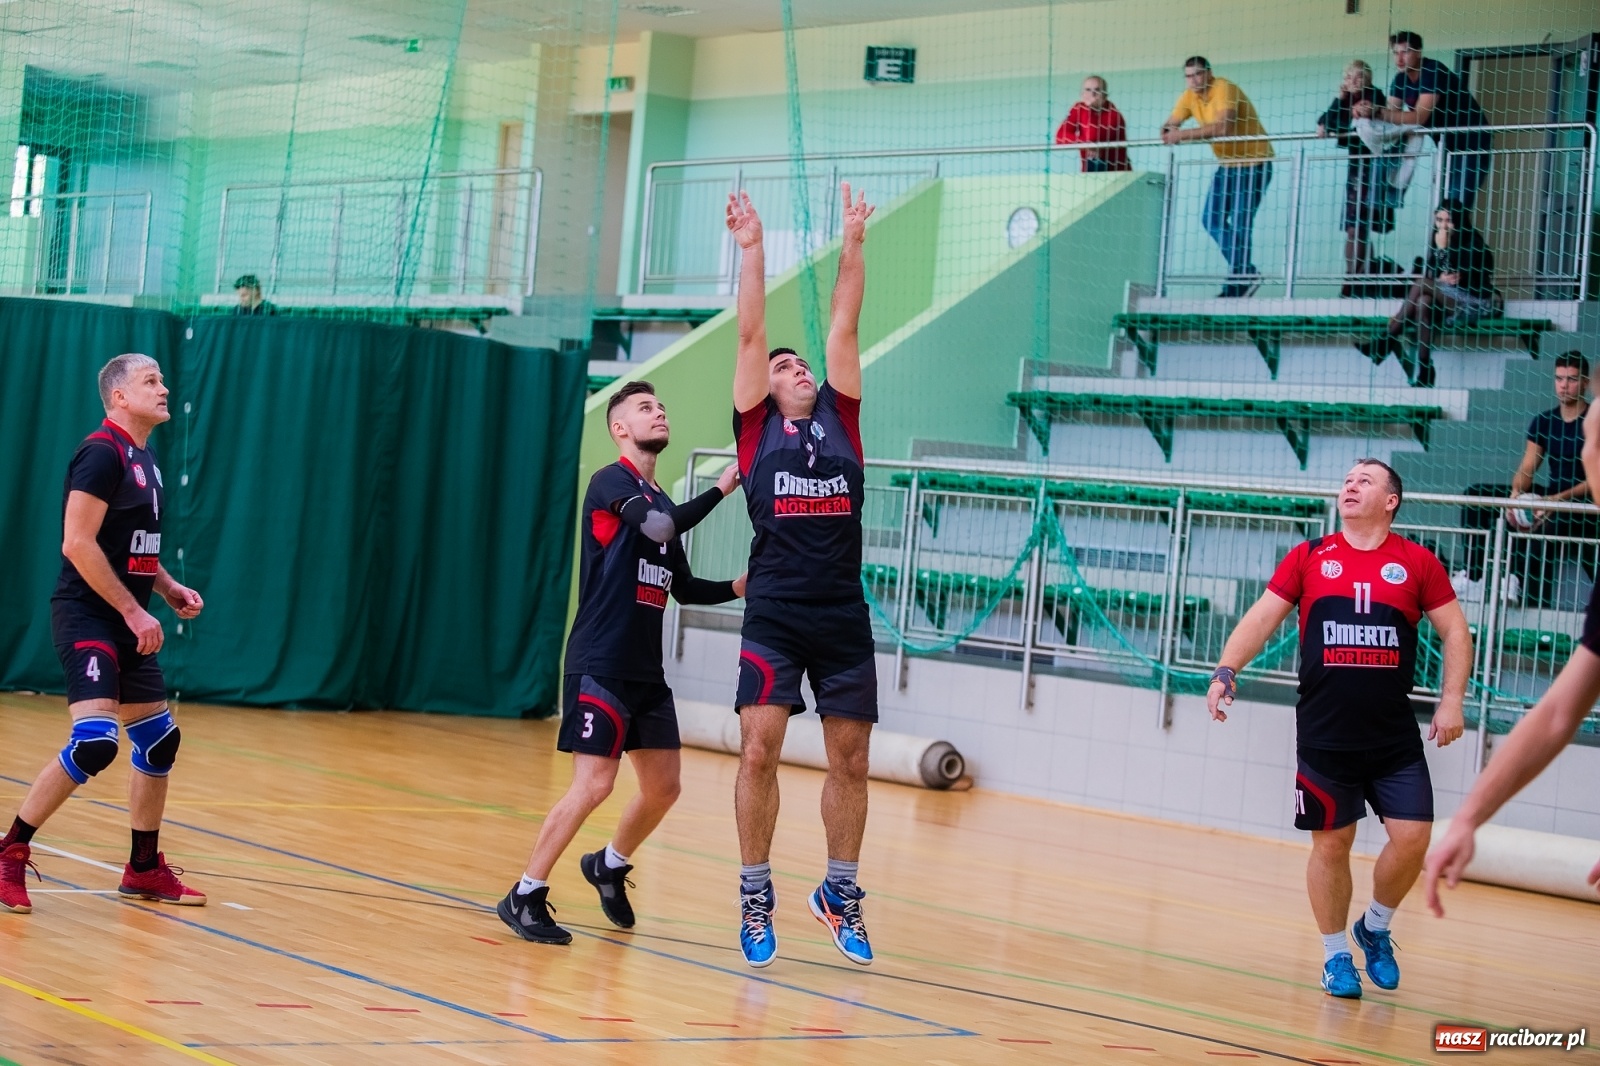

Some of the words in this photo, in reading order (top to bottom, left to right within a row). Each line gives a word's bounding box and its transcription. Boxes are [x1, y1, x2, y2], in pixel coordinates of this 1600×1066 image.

[878, 59, 902, 79] E
[774, 471, 850, 497] OMERTA
[774, 496, 851, 515] NORTHERN
[1353, 582, 1371, 614] 11
[1323, 620, 1399, 647] OMERTA
[86, 656, 100, 681] 4
[1323, 648, 1399, 665] NORTHERN
[582, 712, 594, 738] 3
